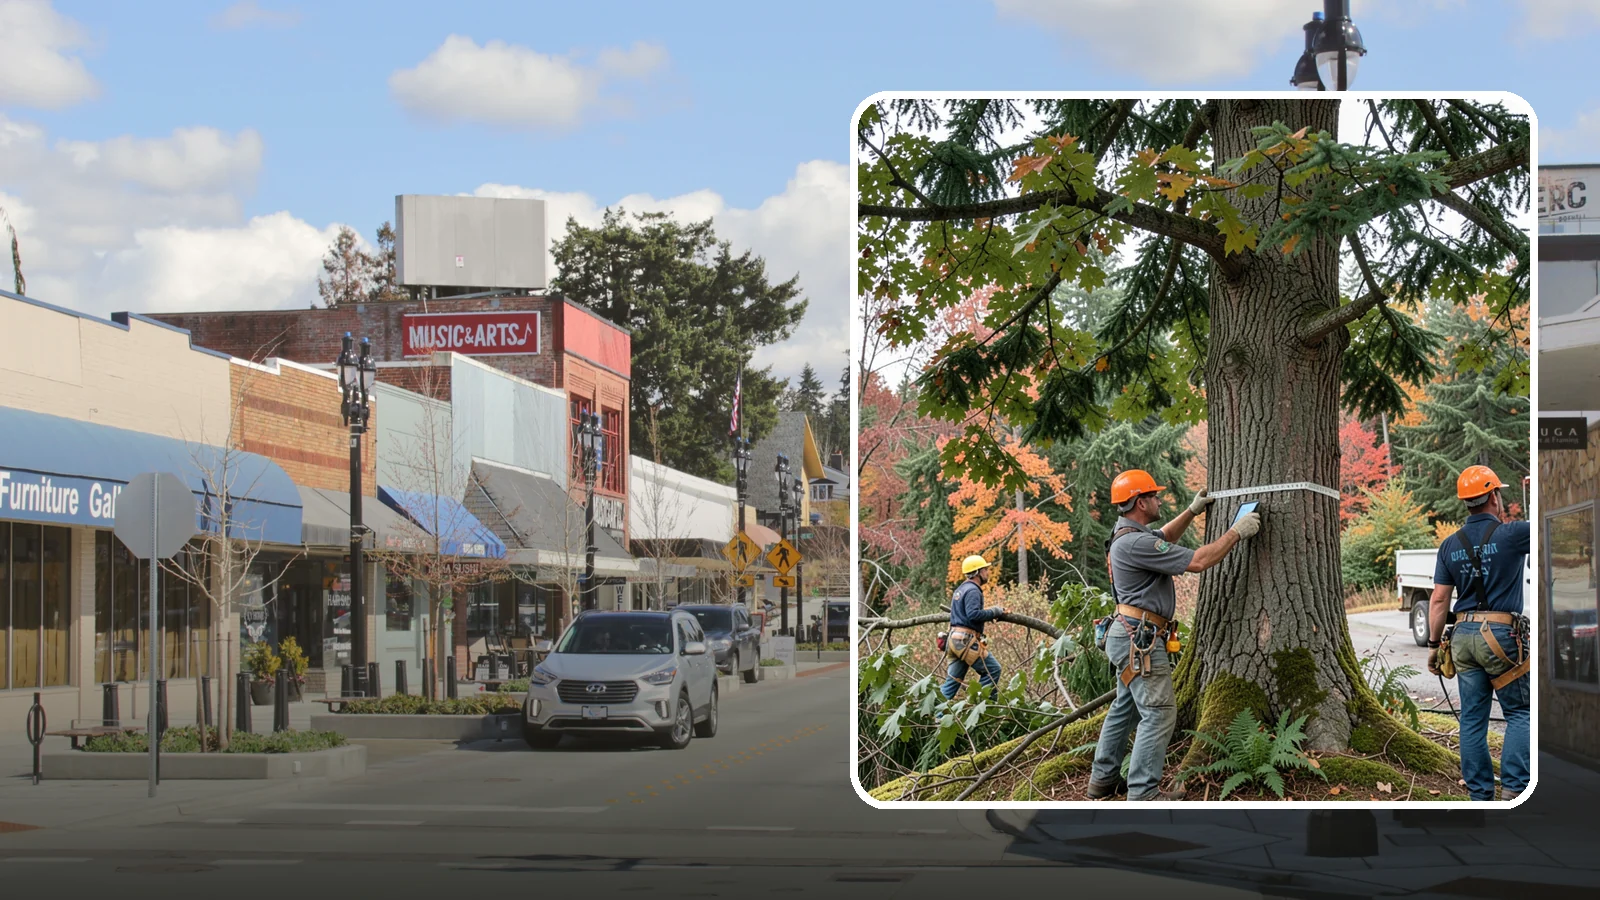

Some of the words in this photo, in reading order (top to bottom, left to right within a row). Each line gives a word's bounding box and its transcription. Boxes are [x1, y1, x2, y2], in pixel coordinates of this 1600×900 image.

[0, 471, 79, 515] Furniture
[89, 482, 122, 519] Gal
[453, 563, 480, 574] SUSHI
